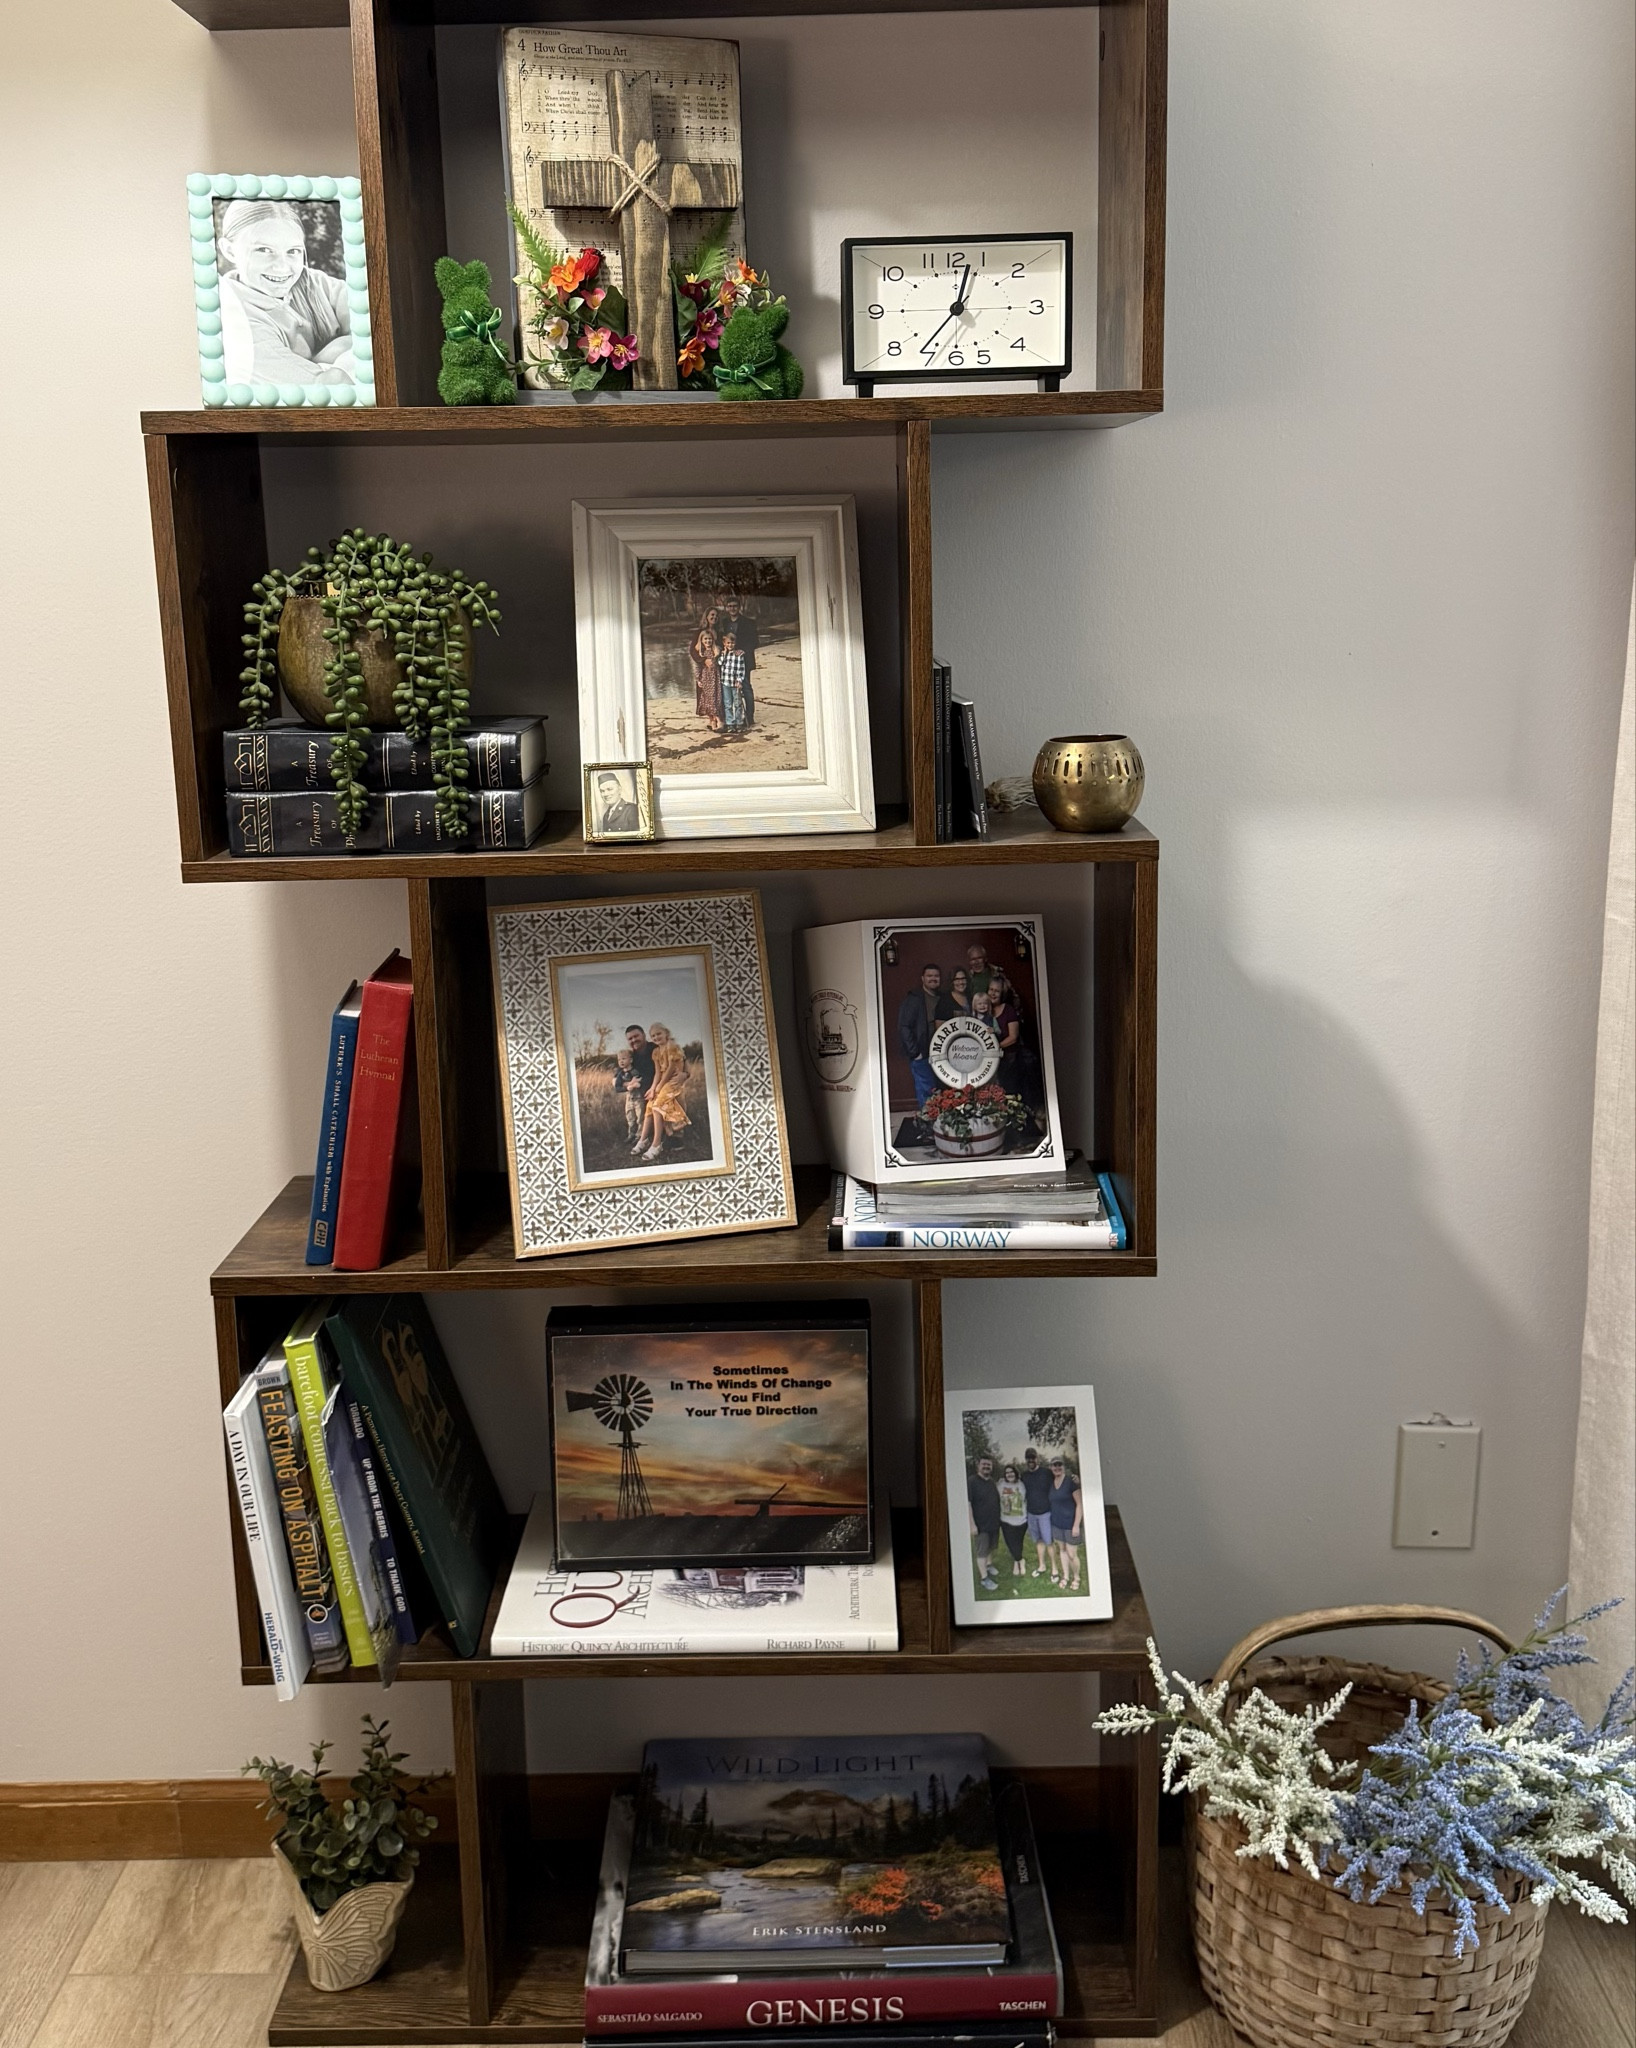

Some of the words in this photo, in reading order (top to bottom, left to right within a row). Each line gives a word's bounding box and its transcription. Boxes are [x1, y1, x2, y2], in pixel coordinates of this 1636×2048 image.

[518, 38, 526, 51] 4
[533, 42, 556, 53] How
[558, 43, 583, 54] Great
[585, 44, 610, 56] Thou
[613, 46, 627, 56] Art
[923, 253, 934, 268] 11
[947, 252, 965, 268] 12
[982, 251, 985, 267] 1
[883, 266, 904, 281] 10
[1011, 262, 1025, 278] 2
[868, 304, 884, 319] 9
[1028, 300, 1044, 315] 3
[887, 341, 902, 356] 8
[1009, 337, 1026, 351] 4
[948, 351, 964, 365] 6
[977, 350, 991, 365] 5
[306, 741, 320, 787] Treasury
[309, 801, 322, 847] Treasury
[373, 1033, 390, 1045] The
[933, 1021, 959, 1053] MARK
[965, 1021, 995, 1050] TWAIN
[336, 1034, 346, 1076] LUTHER'S
[951, 1044, 979, 1052] Welcome
[360, 1049, 399, 1064] Lutheran
[360, 1065, 395, 1081] Hymnal
[938, 1064, 950, 1078] PORT
[970, 1061, 993, 1083] HANNIBAL
[333, 1080, 342, 1107] SMALL
[327, 1110, 339, 1158] CATECHISM
[913, 1230, 1011, 1248] NORWAY
[713, 1365, 789, 1376] Sometimes
[258, 1376, 281, 1386] BROWN
[295, 1354, 319, 1421] barefoot
[670, 1381, 683, 1391] In
[687, 1380, 713, 1390] The
[717, 1378, 757, 1389] Winds
[762, 1378, 777, 1388] Of
[781, 1378, 832, 1390] Change
[722, 1393, 748, 1403] You
[752, 1392, 781, 1402] Find
[685, 1407, 717, 1417] Your
[721, 1406, 751, 1416] True
[756, 1406, 818, 1416] Direction
[349, 1401, 365, 1439] TORNADO
[228, 1430, 240, 1438] A
[261, 1390, 299, 1479] FEASTING
[231, 1441, 245, 1463] DAY
[308, 1424, 332, 1490] contessa
[362, 1458, 372, 1470] UP
[236, 1467, 249, 1481] IN
[365, 1470, 378, 1493] FROM
[240, 1482, 255, 1514] OUR
[280, 1486, 305, 1512] ON
[371, 1493, 382, 1509] THE
[323, 1492, 341, 1529] back
[245, 1514, 261, 1542] LIFE
[375, 1510, 389, 1539] DEBRIS
[332, 1532, 343, 1548] to
[287, 1520, 324, 1597] ASPHALT
[386, 1556, 395, 1568] TO
[335, 1550, 355, 1597] basics
[389, 1568, 402, 1594] THANK
[395, 1596, 406, 1612] GOD
[264, 1612, 285, 1682] HERALD-WHIG
[521, 1641, 571, 1653] HISTORIC
[571, 1641, 613, 1653] QUINCY
[614, 1638, 690, 1652] ARCHITECTURE
[767, 1638, 812, 1650] RICHARD
[815, 1638, 845, 1650] PAYNE
[705, 1755, 800, 1774] WILD
[814, 1754, 923, 1773] LIGHT
[752, 1926, 789, 1936] ERIK
[795, 1924, 887, 1935] STENSLAND
[746, 1996, 904, 2026] GENESIS
[999, 2001, 1047, 2012] TASCHEN
[653, 2011, 703, 2022] SALGADO
